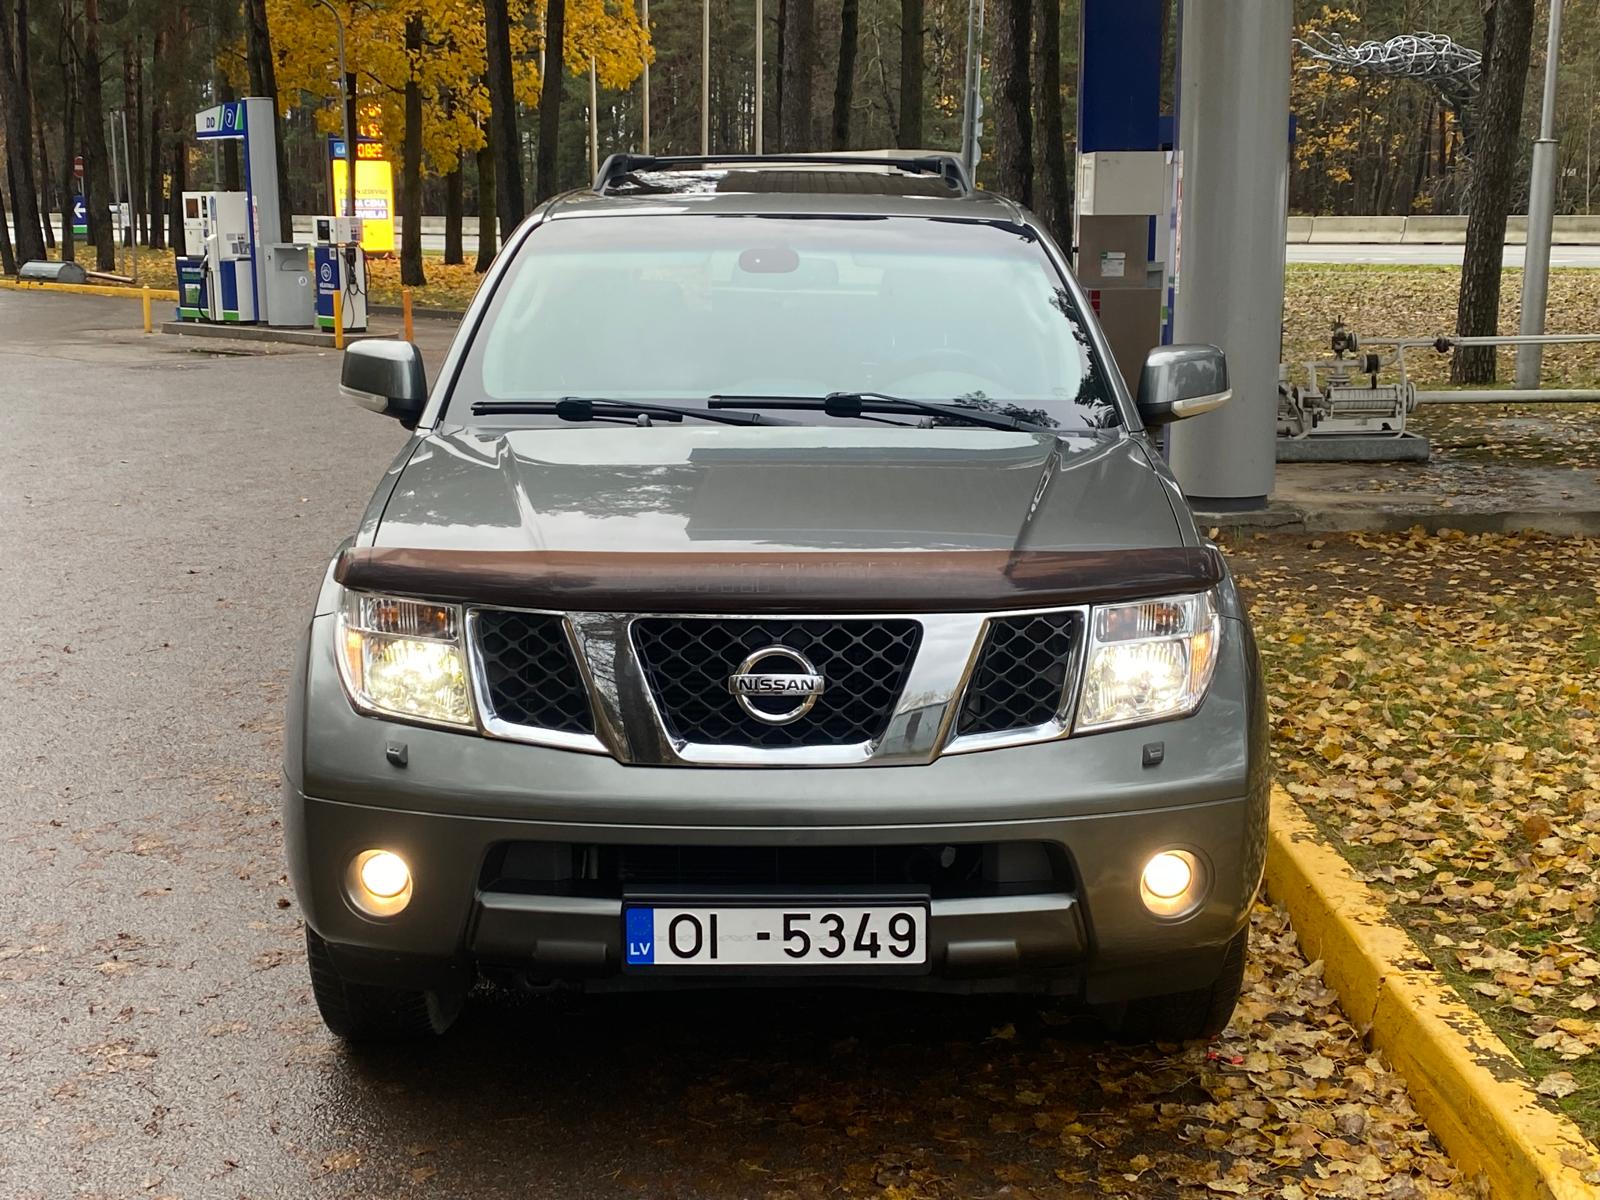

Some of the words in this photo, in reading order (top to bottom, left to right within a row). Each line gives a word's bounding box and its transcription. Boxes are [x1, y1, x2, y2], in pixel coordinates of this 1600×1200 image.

[739, 679, 815, 691] NISSAN
[668, 913, 718, 959] OI
[756, 912, 916, 958] -5349
[629, 942, 651, 956] LV
